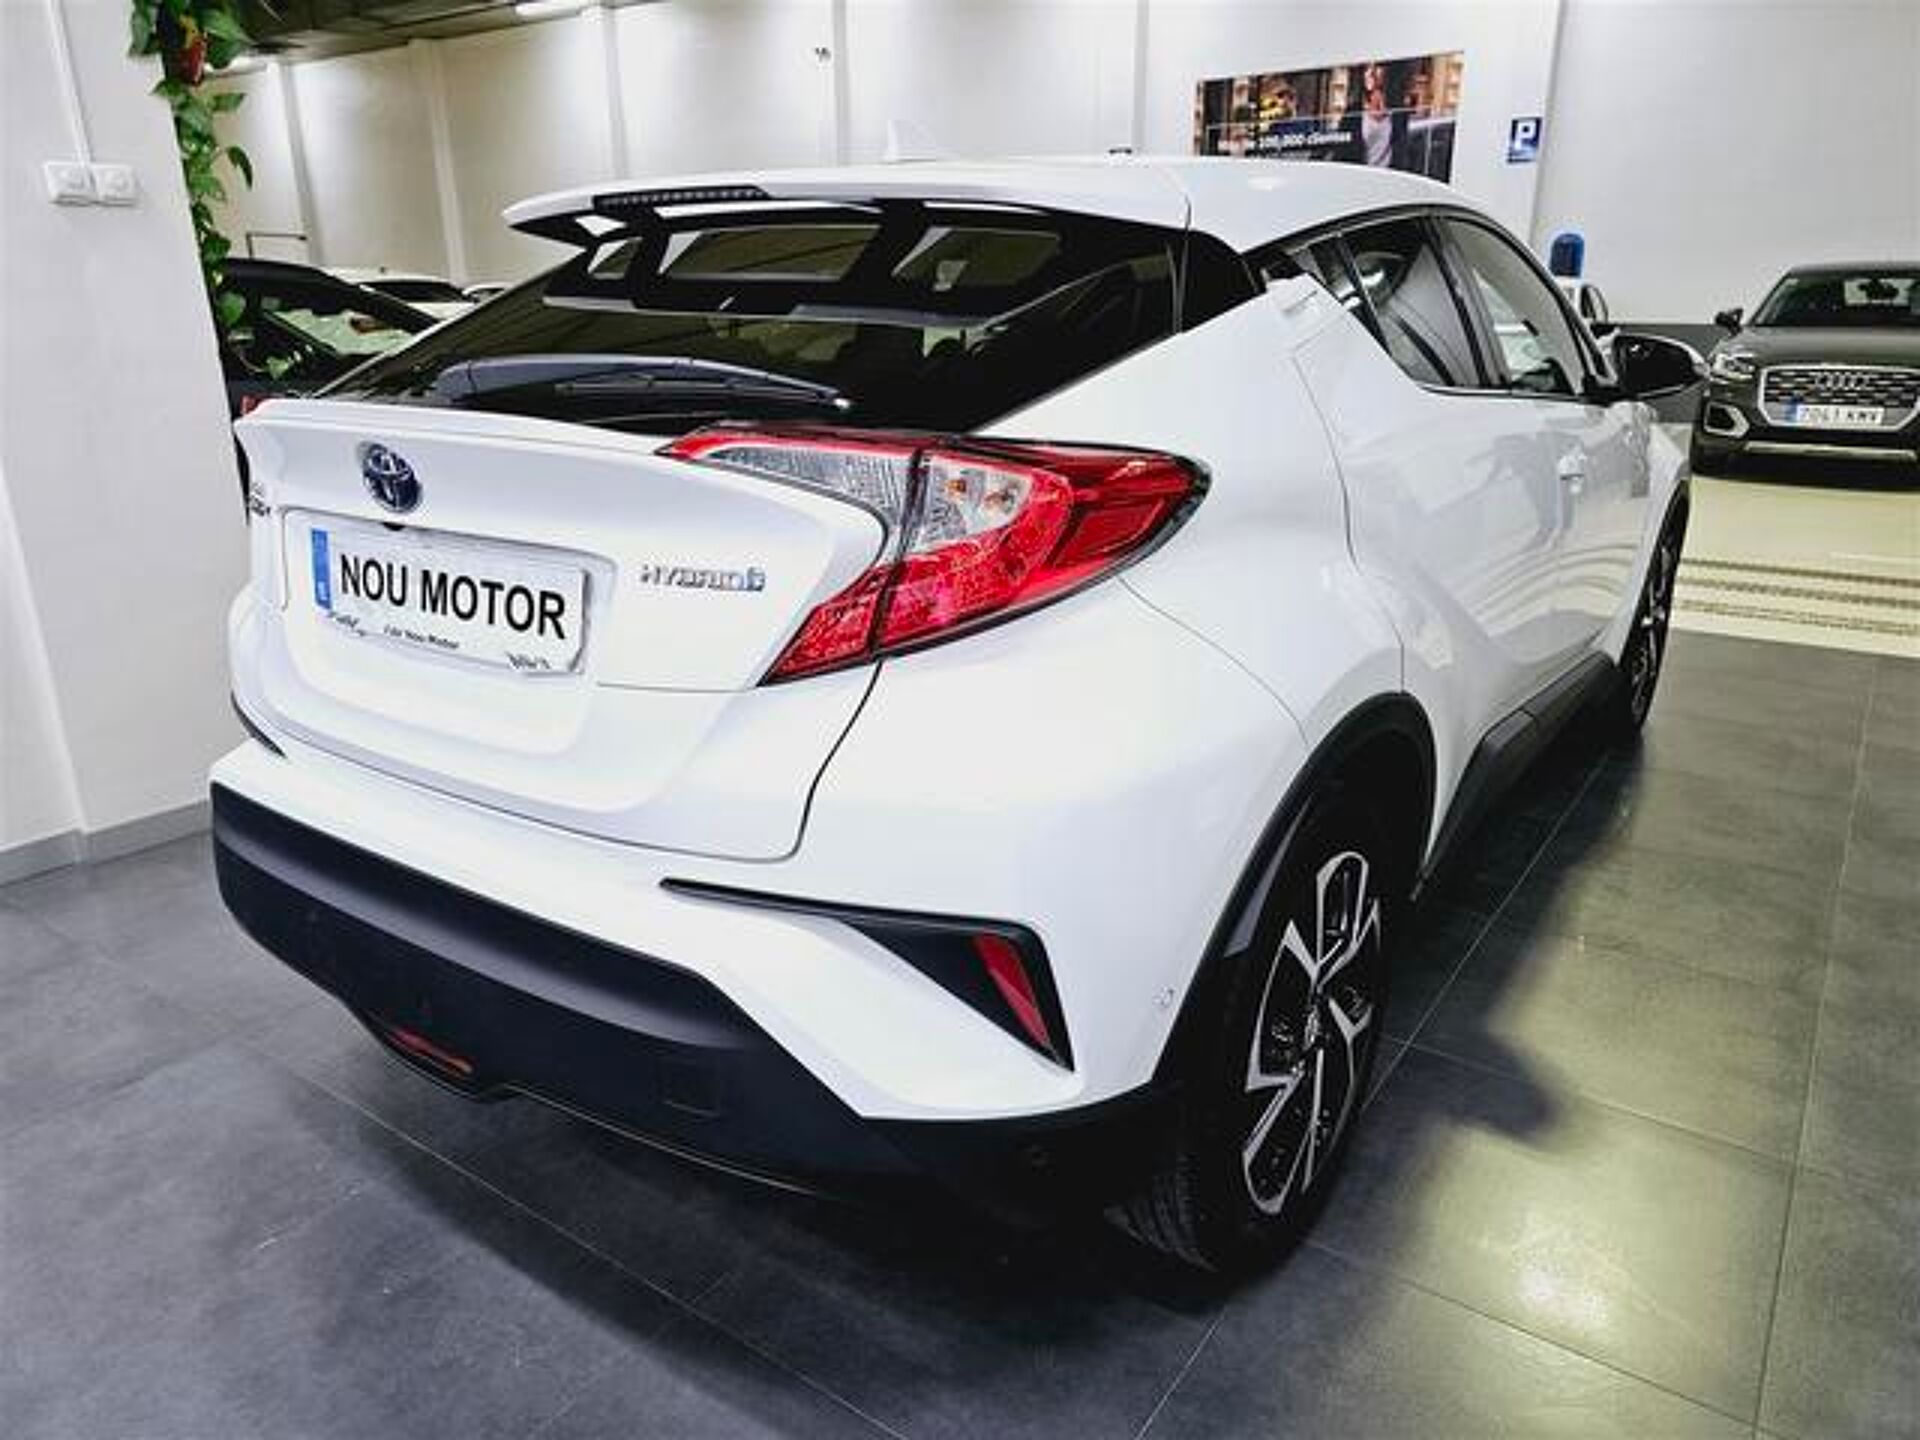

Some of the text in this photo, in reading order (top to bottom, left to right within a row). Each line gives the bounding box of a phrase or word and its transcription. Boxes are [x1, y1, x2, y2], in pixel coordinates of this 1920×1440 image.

[1514, 121, 1536, 151] P
[340, 553, 408, 607] NOU
[420, 569, 566, 640] MOTOR
